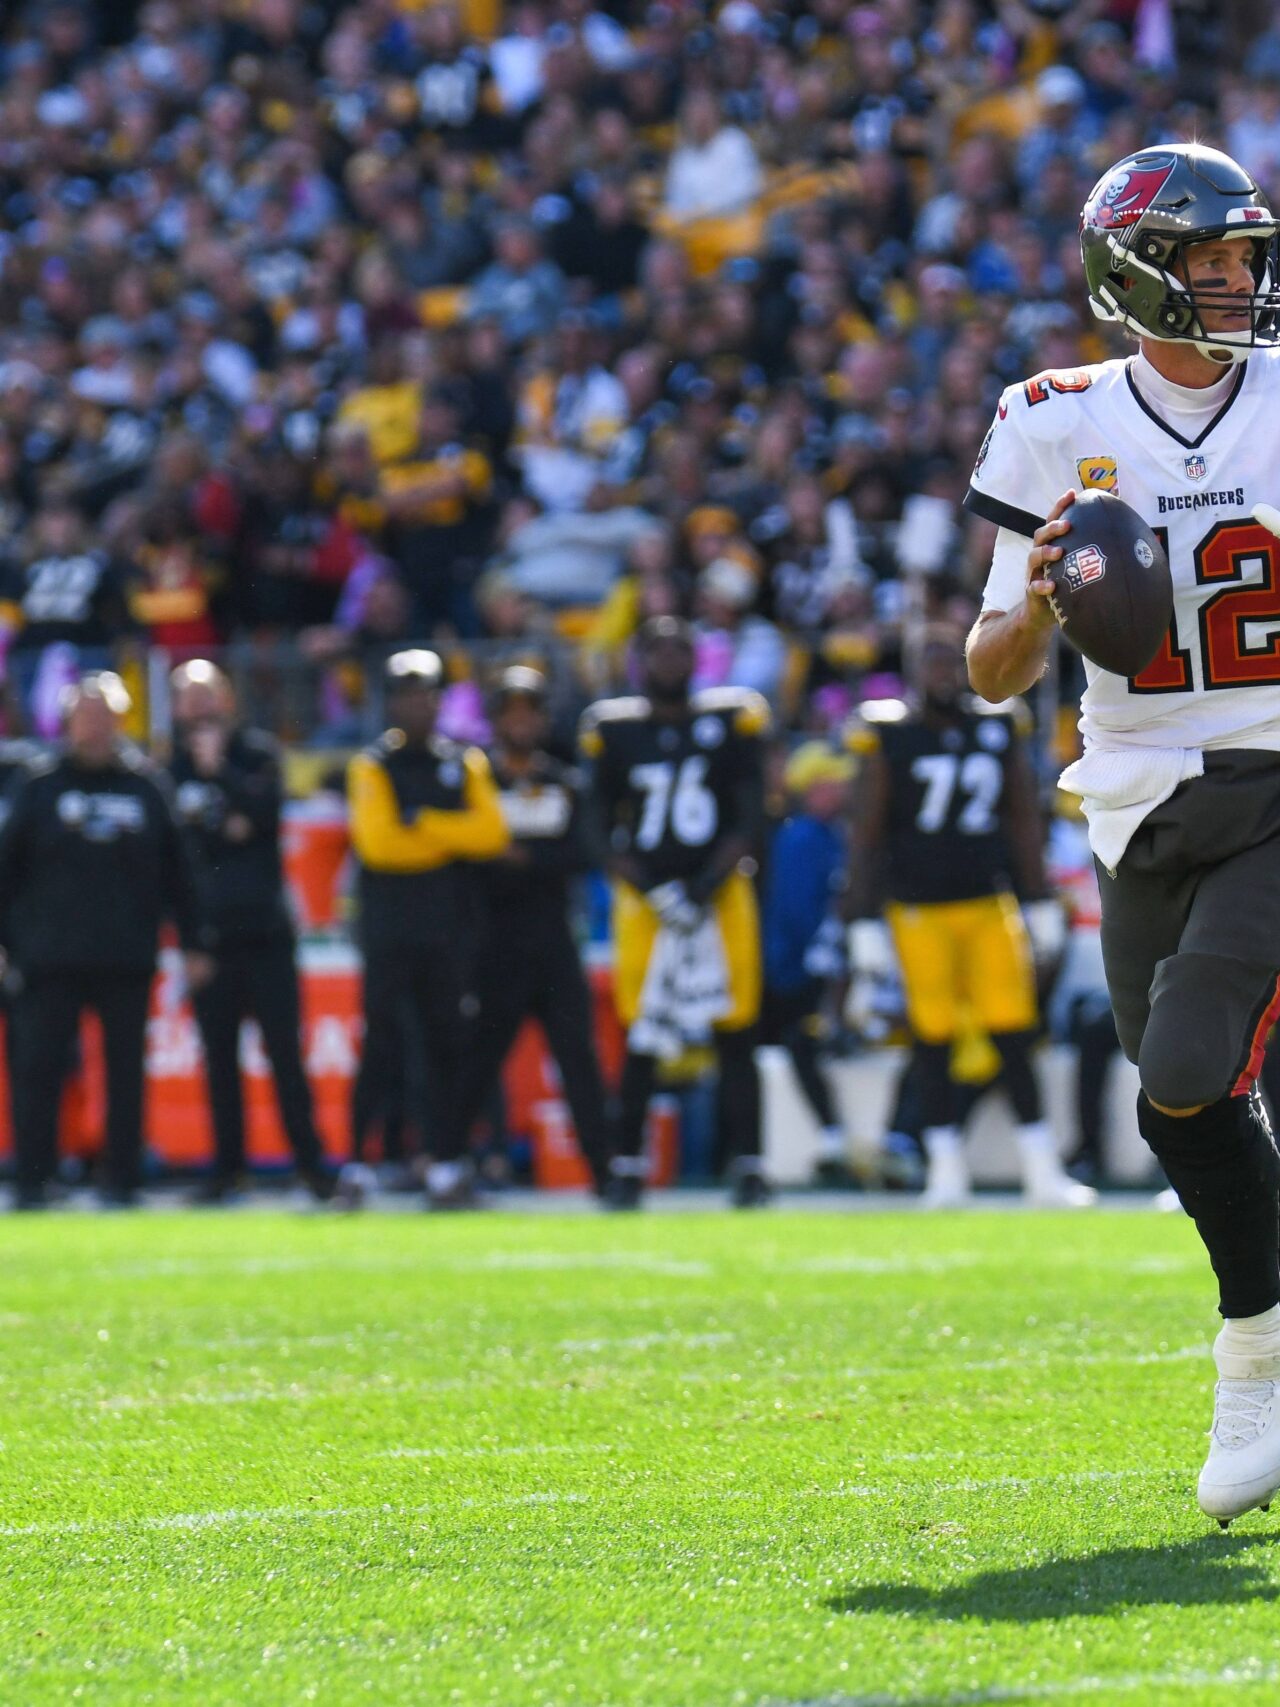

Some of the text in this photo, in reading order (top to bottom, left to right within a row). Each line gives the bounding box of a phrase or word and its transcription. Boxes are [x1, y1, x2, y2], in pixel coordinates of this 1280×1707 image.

[1188, 464, 1206, 477] NFL
[1157, 487, 1245, 514] BUCCANEERS
[1078, 547, 1102, 582] NFL
[629, 754, 718, 852] 76
[911, 752, 1003, 834] 72
